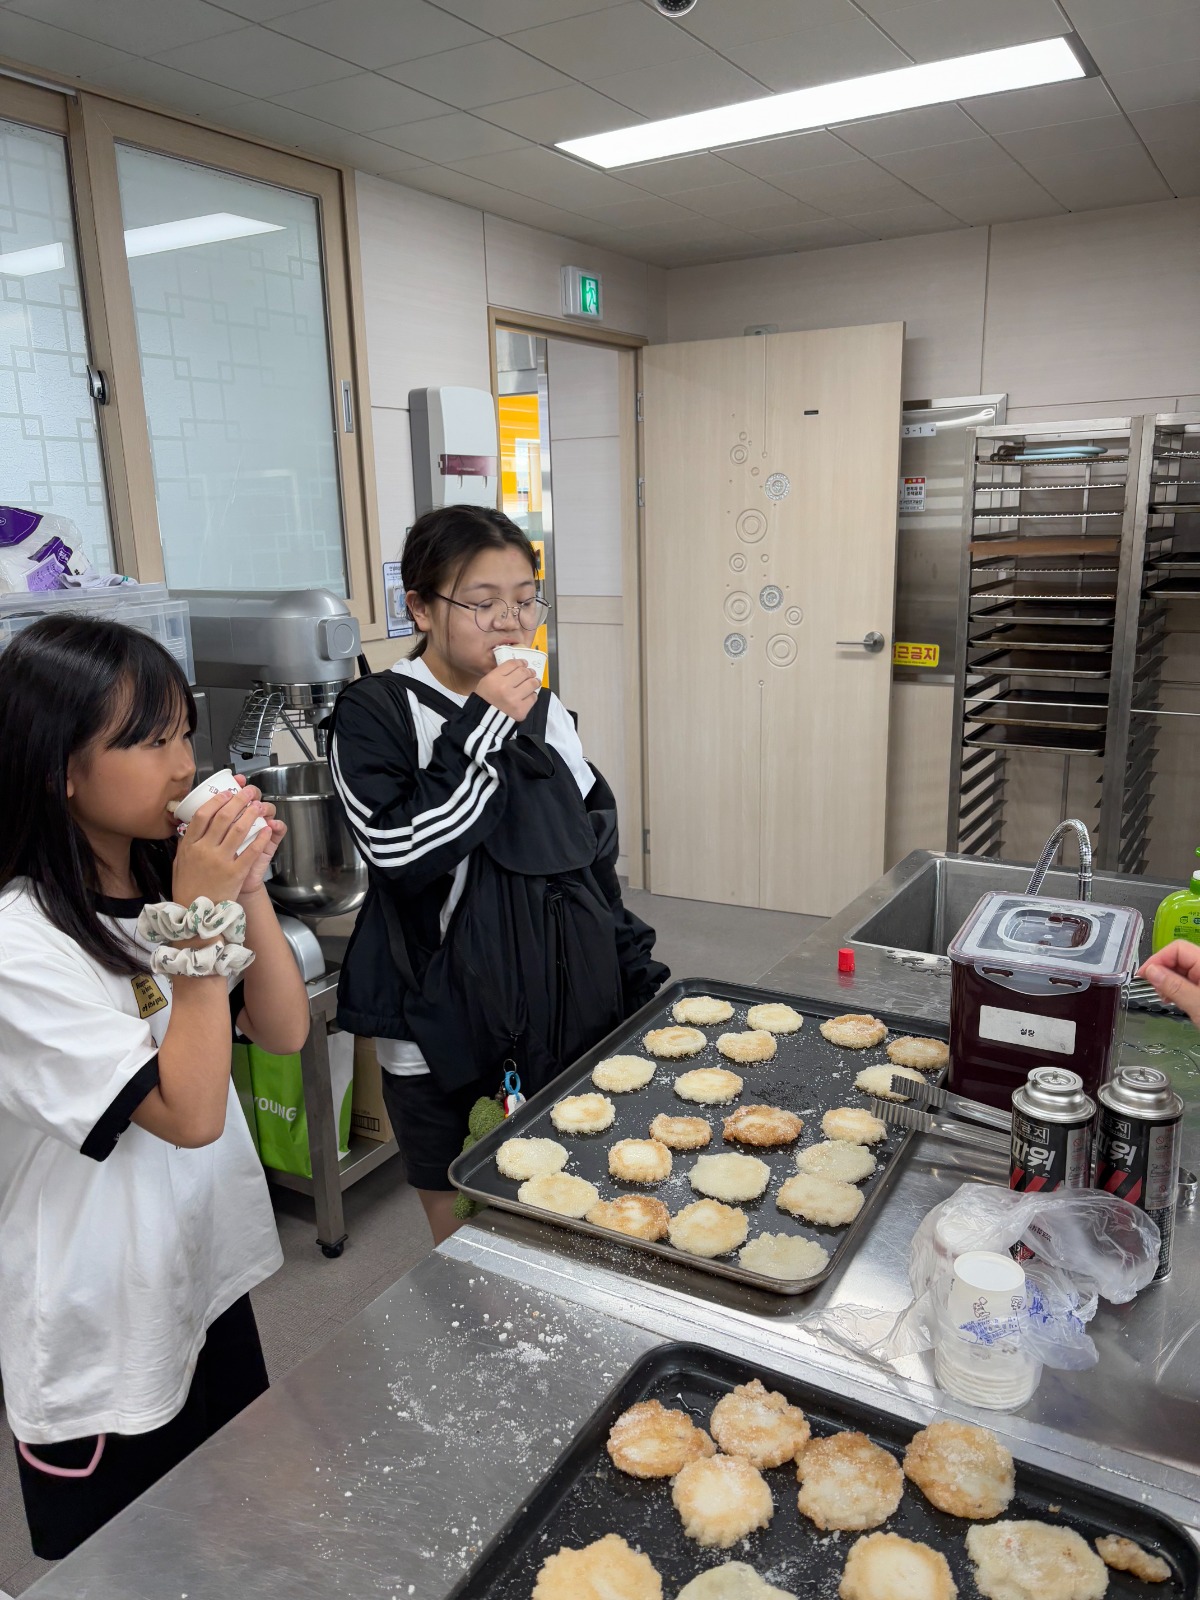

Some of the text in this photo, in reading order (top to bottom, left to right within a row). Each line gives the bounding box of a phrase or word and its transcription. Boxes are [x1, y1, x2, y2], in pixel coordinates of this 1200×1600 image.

[893, 645, 936, 661] 근금지
[1020, 1028, 1035, 1037] 설탕
[1012, 1136, 1056, 1171] 파워
